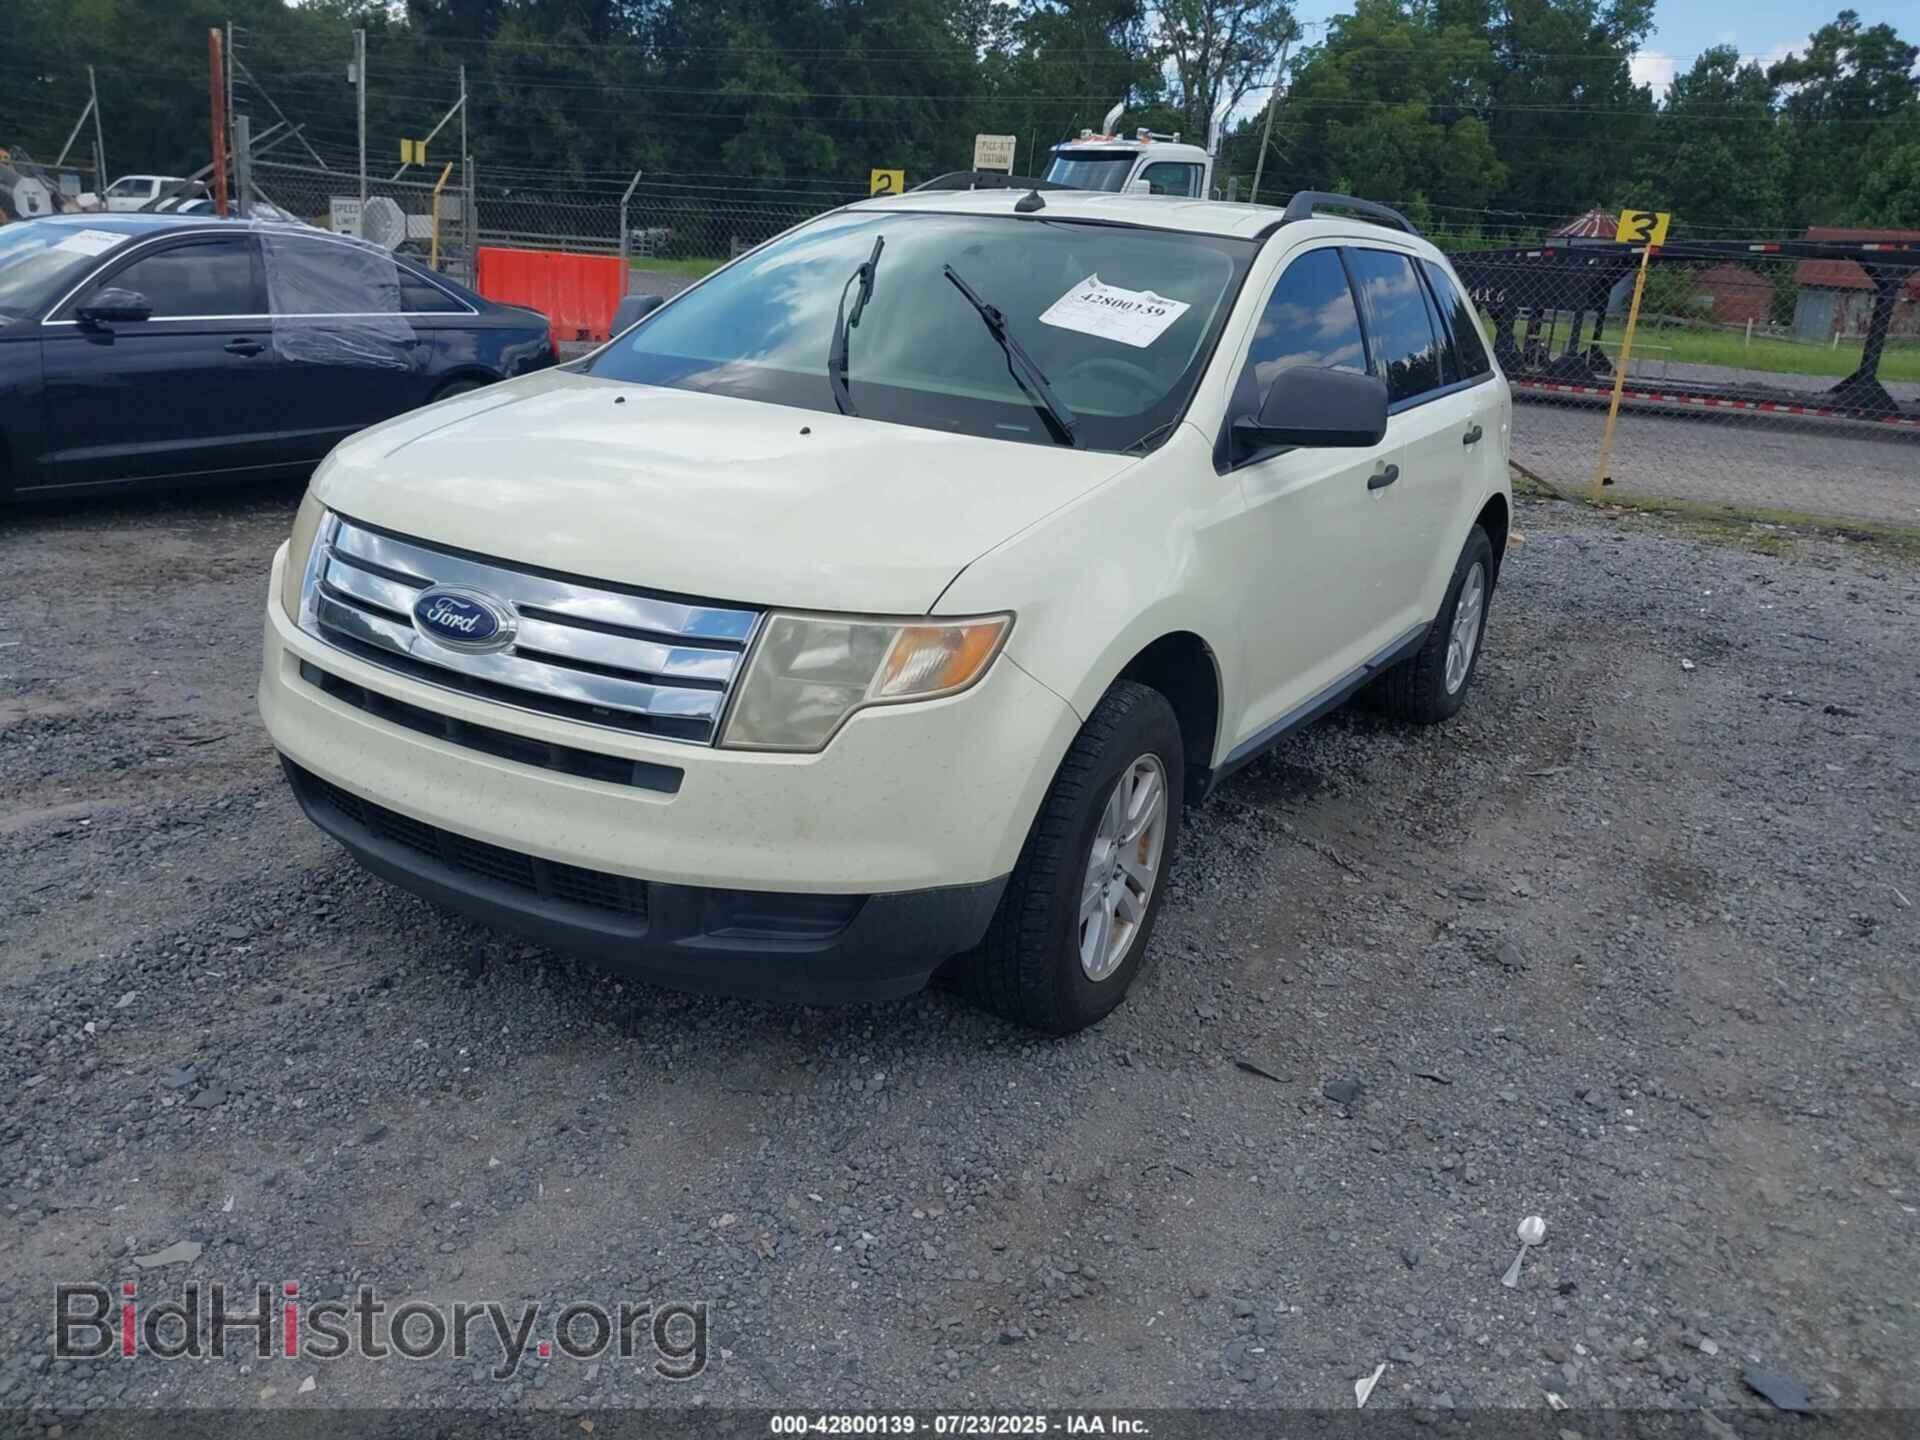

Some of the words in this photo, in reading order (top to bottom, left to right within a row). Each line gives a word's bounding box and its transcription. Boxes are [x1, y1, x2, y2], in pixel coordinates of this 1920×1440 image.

[874, 174, 897, 196] 2
[1627, 212, 1658, 245] 3
[426, 596, 482, 633] Ford
